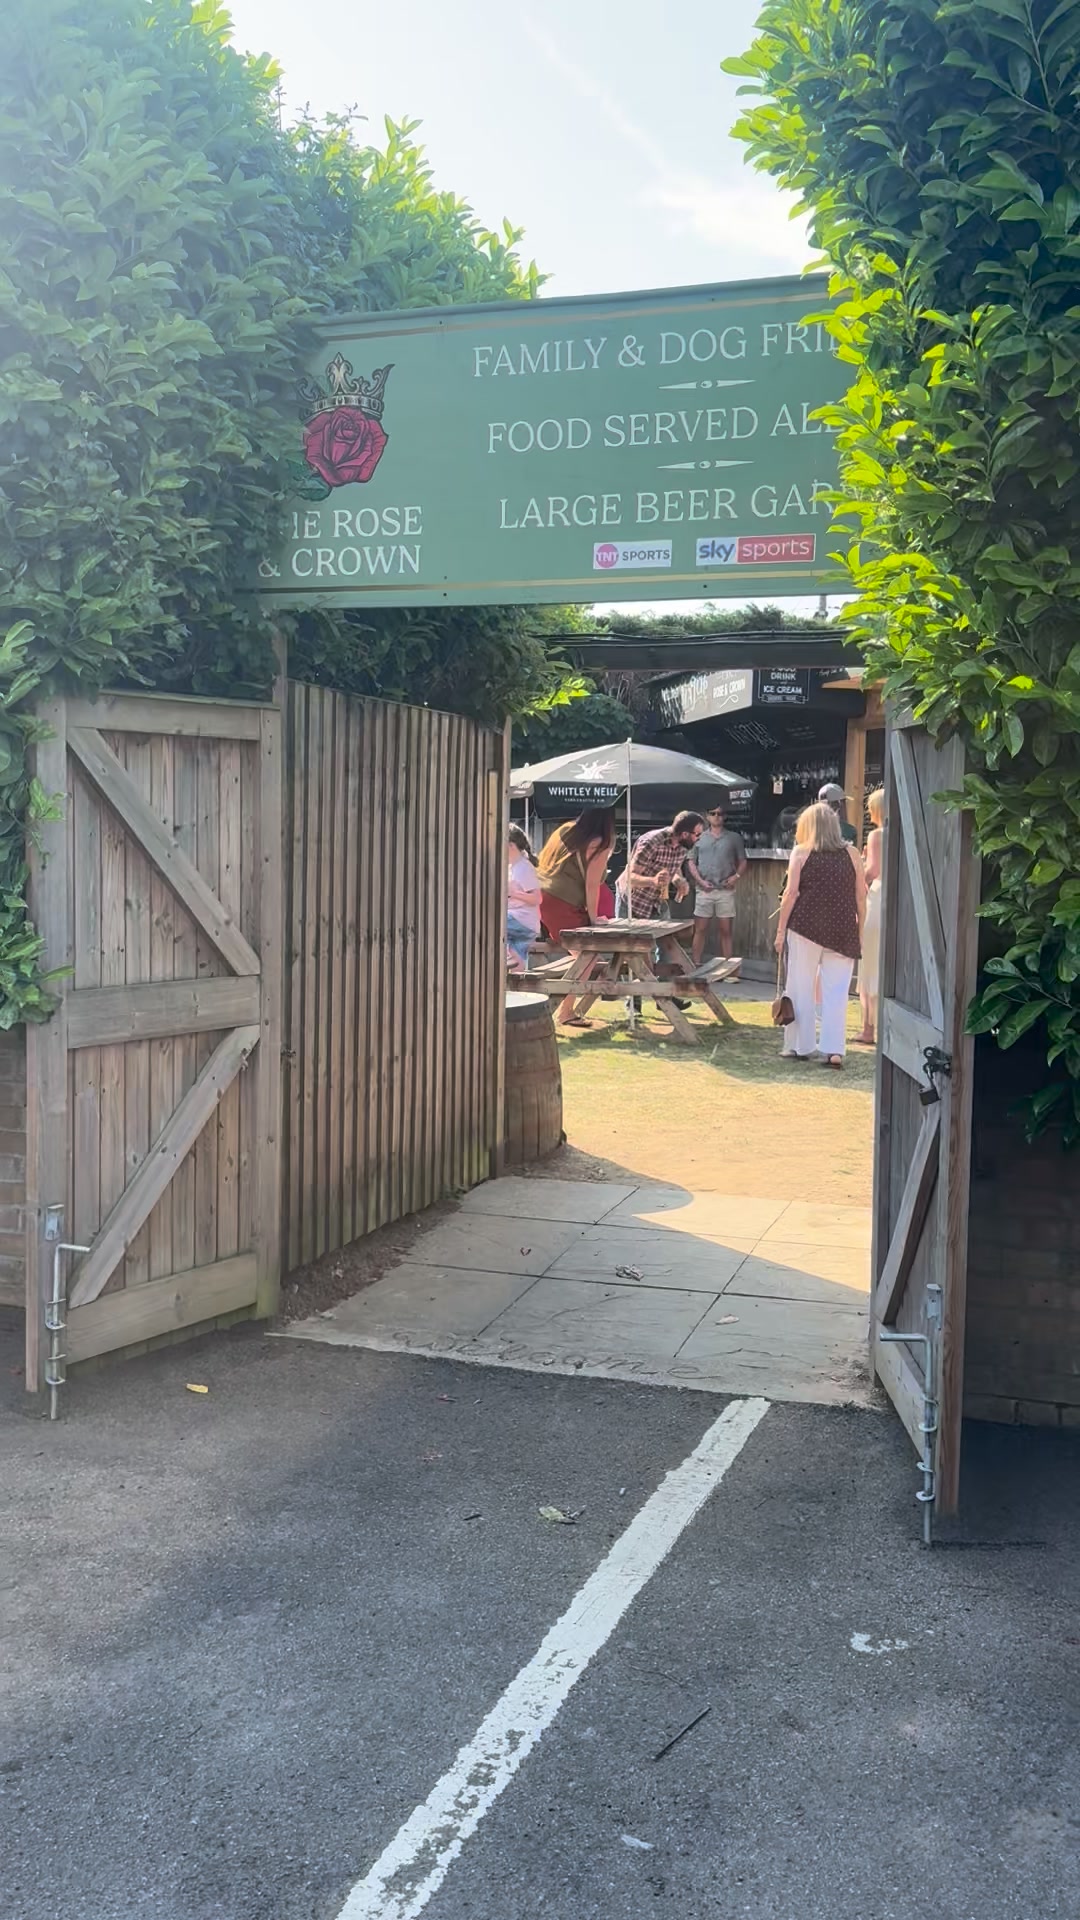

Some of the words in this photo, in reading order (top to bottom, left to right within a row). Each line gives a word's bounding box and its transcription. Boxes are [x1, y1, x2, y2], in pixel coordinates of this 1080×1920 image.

[472, 337, 607, 377] FAMILY
[618, 334, 646, 367] &
[659, 326, 747, 364] DOG
[487, 417, 591, 454] FOOD
[603, 406, 759, 448] SERVED
[333, 506, 423, 538] ROSE
[499, 493, 622, 529] LARGE
[635, 488, 738, 523] BEER
[291, 545, 421, 577] CROWN
[596, 551, 619, 562] TNT
[622, 549, 670, 561] SPORTS
[698, 540, 735, 562] sky
[742, 539, 810, 560] sports
[763, 685, 775, 693] ICE
[776, 686, 803, 694] CREAM
[770, 672, 796, 681] DRINK
[548, 786, 591, 796] WHITLEY
[593, 786, 618, 796] NEILL
